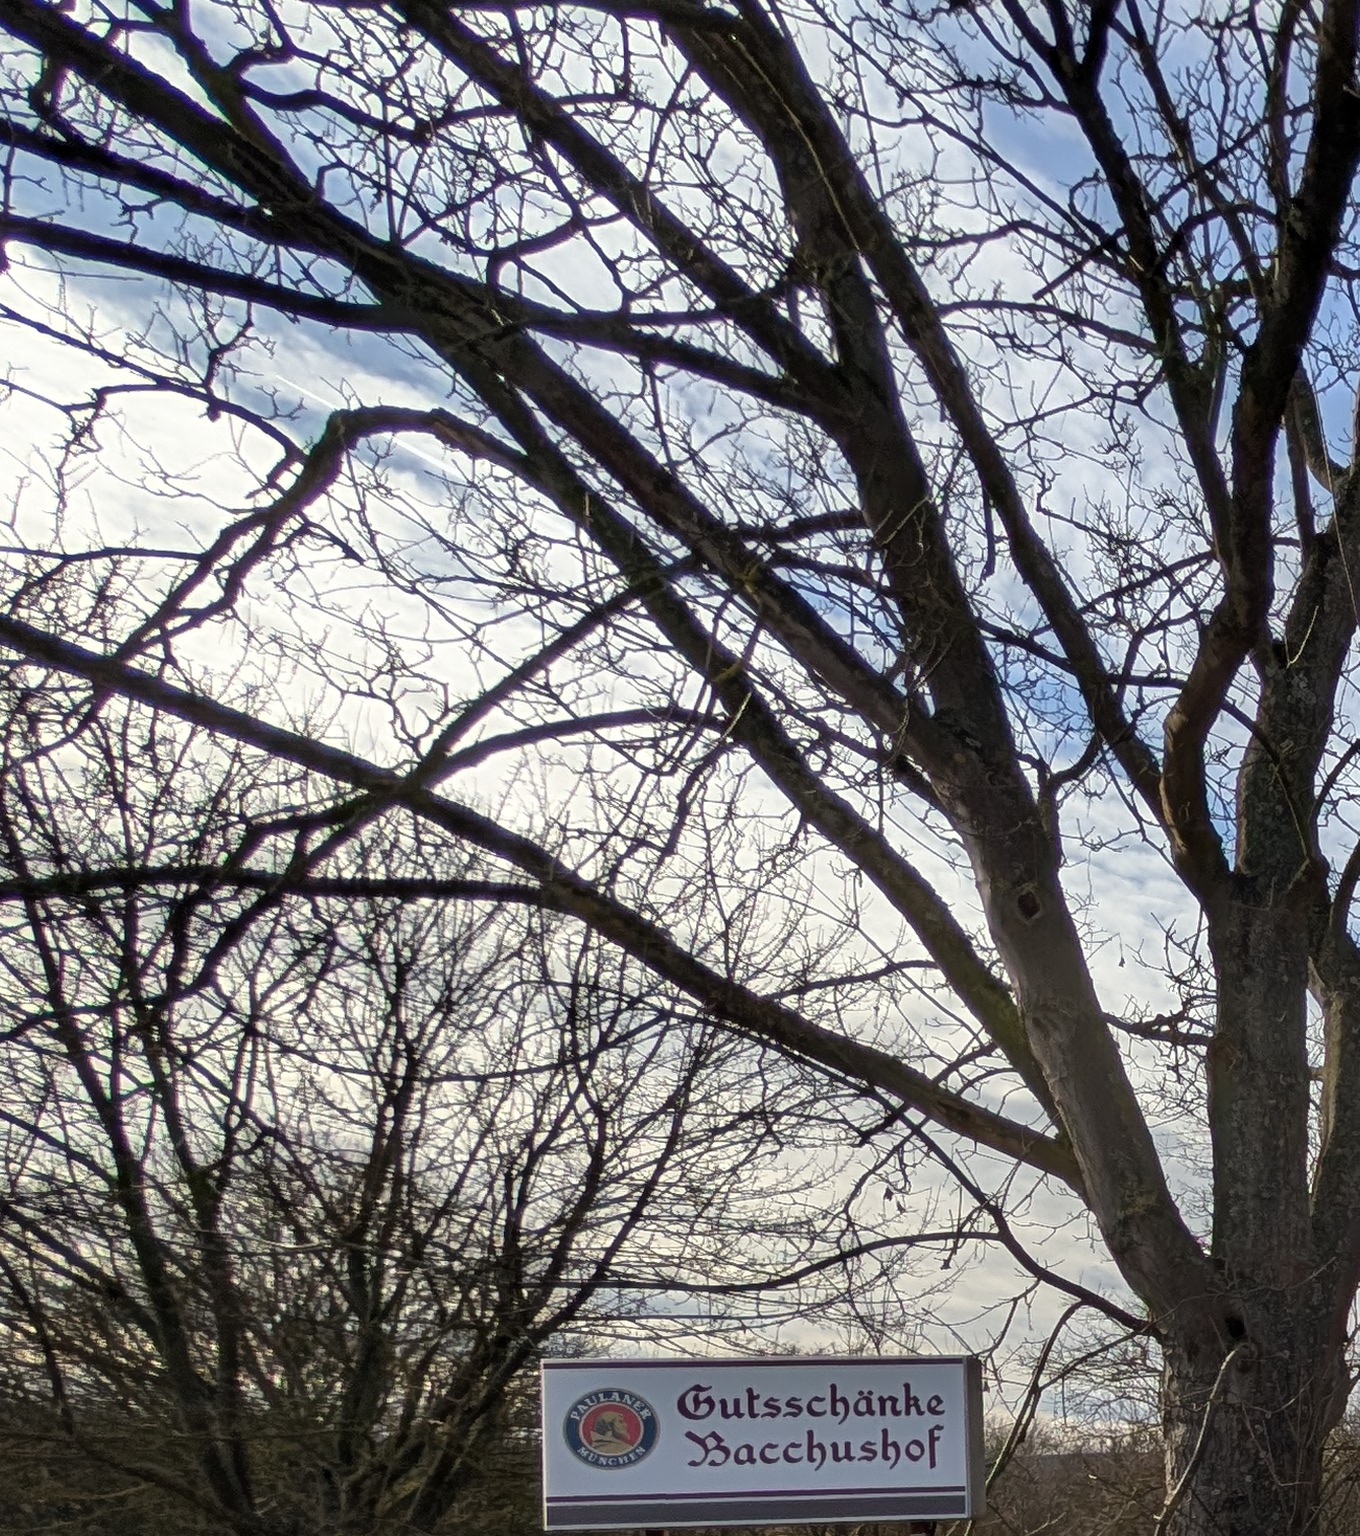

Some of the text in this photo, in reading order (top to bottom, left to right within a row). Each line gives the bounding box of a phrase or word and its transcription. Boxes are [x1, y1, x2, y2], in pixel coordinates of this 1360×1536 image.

[570, 1391, 652, 1421] PAULANER
[676, 1383, 946, 1424] Gutsschänke
[685, 1425, 944, 1471] Bacchushof
